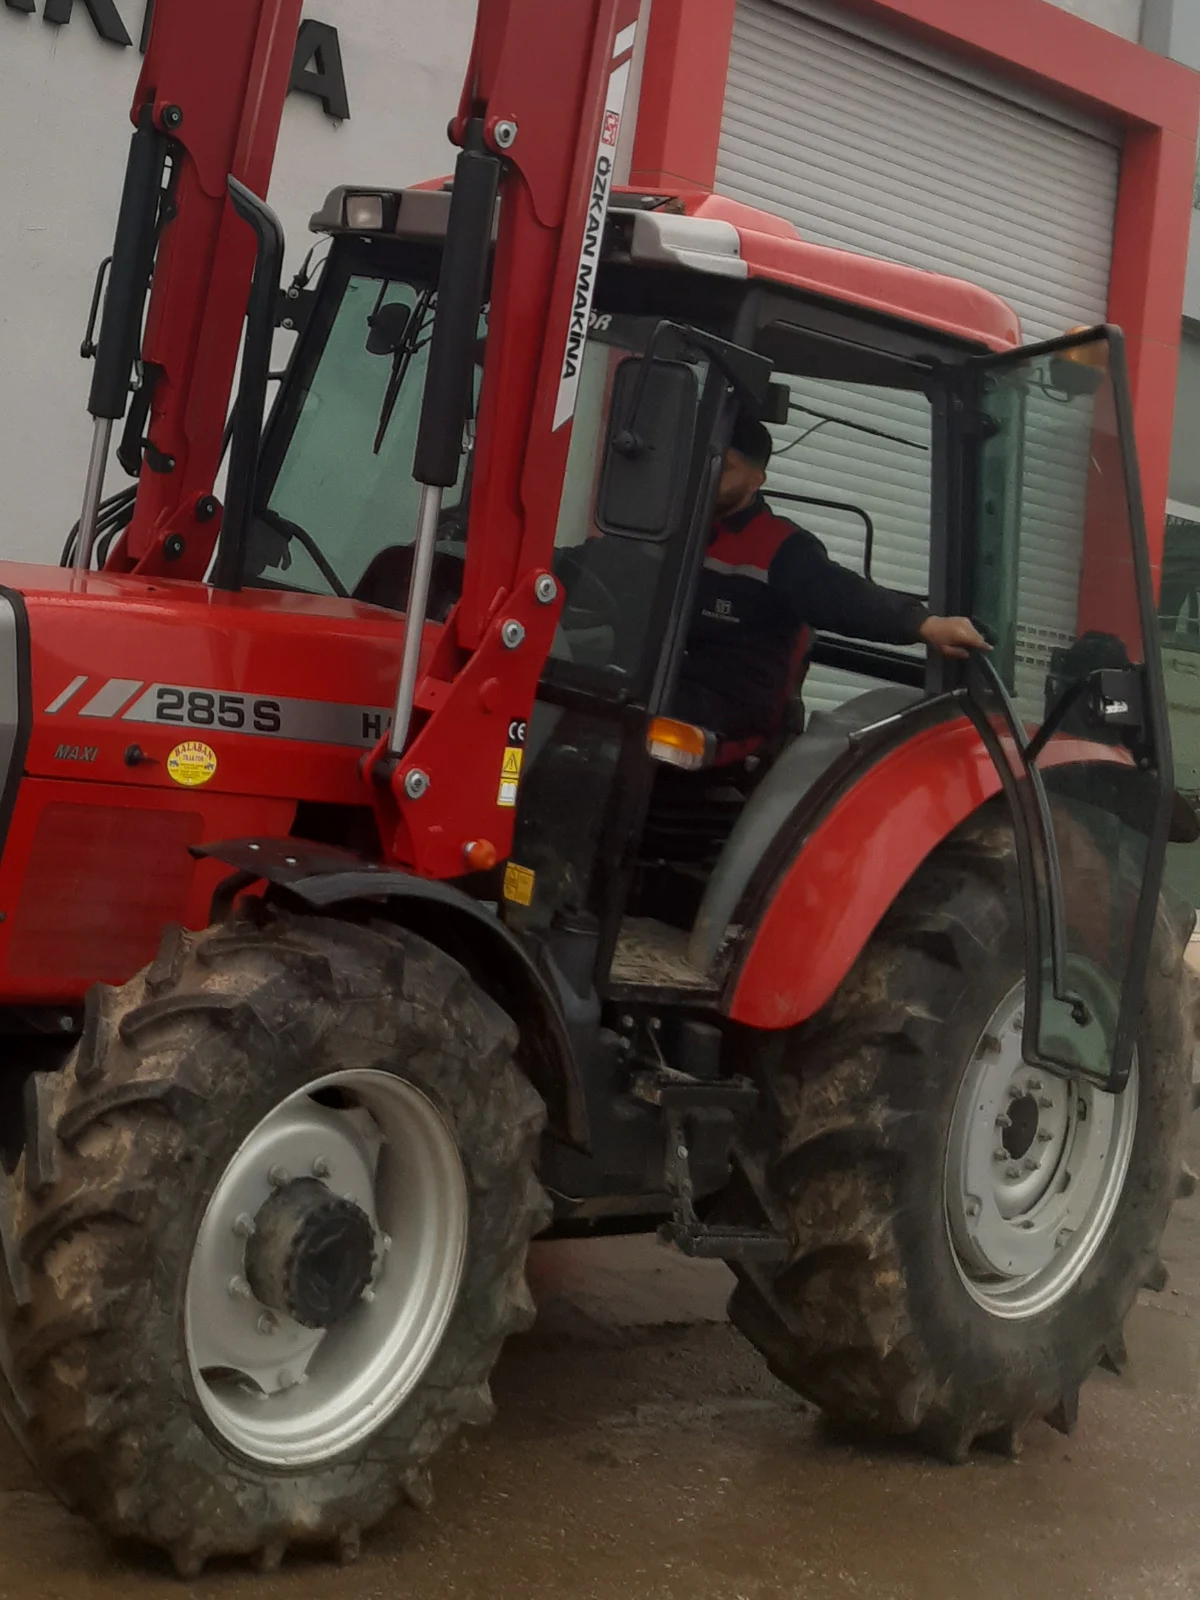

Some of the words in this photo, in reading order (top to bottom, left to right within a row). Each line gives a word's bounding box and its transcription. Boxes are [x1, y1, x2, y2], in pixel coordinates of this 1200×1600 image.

[580, 155, 611, 257] ÖZKAN
[563, 263, 592, 379] MAKİNA
[54, 743, 99, 763] MAXI
[174, 742, 213, 760] BALABAN
